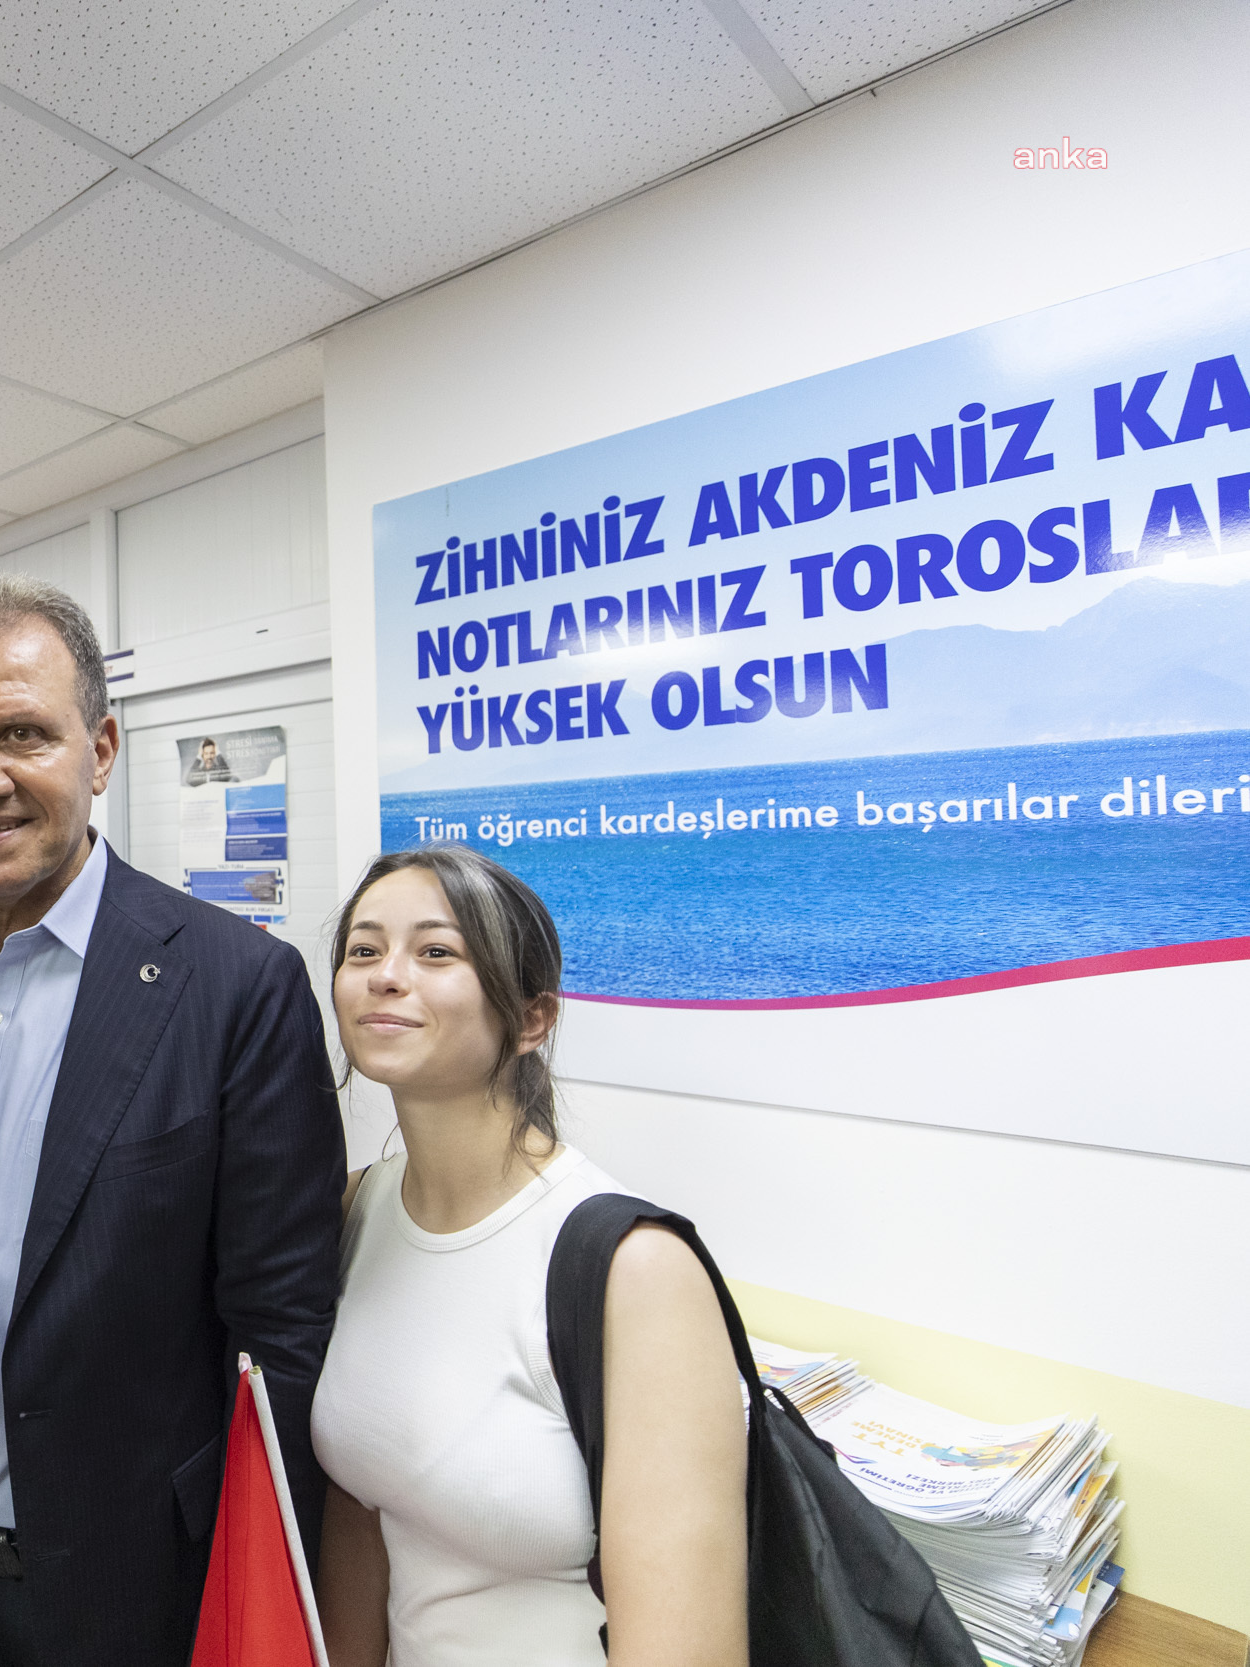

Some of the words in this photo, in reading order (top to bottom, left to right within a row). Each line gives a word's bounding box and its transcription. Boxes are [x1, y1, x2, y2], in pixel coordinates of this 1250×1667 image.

[415, 495, 666, 606] ZİHNİNİZ
[688, 398, 1055, 547] AKDENİZ
[1094, 354, 1250, 461] KA
[417, 564, 768, 679] NOTLARINIZ
[417, 679, 631, 754] YÜKSEK
[651, 643, 889, 731] OLSUN
[415, 816, 468, 842] Tüm
[478, 808, 587, 847] öğrenci
[600, 798, 839, 841] kardeşlerime
[856, 783, 1080, 833] başarılar
[1100, 774, 1250, 818] dileri
[851, 1421, 917, 1448] DENEME
[851, 1433, 906, 1457] TYT
